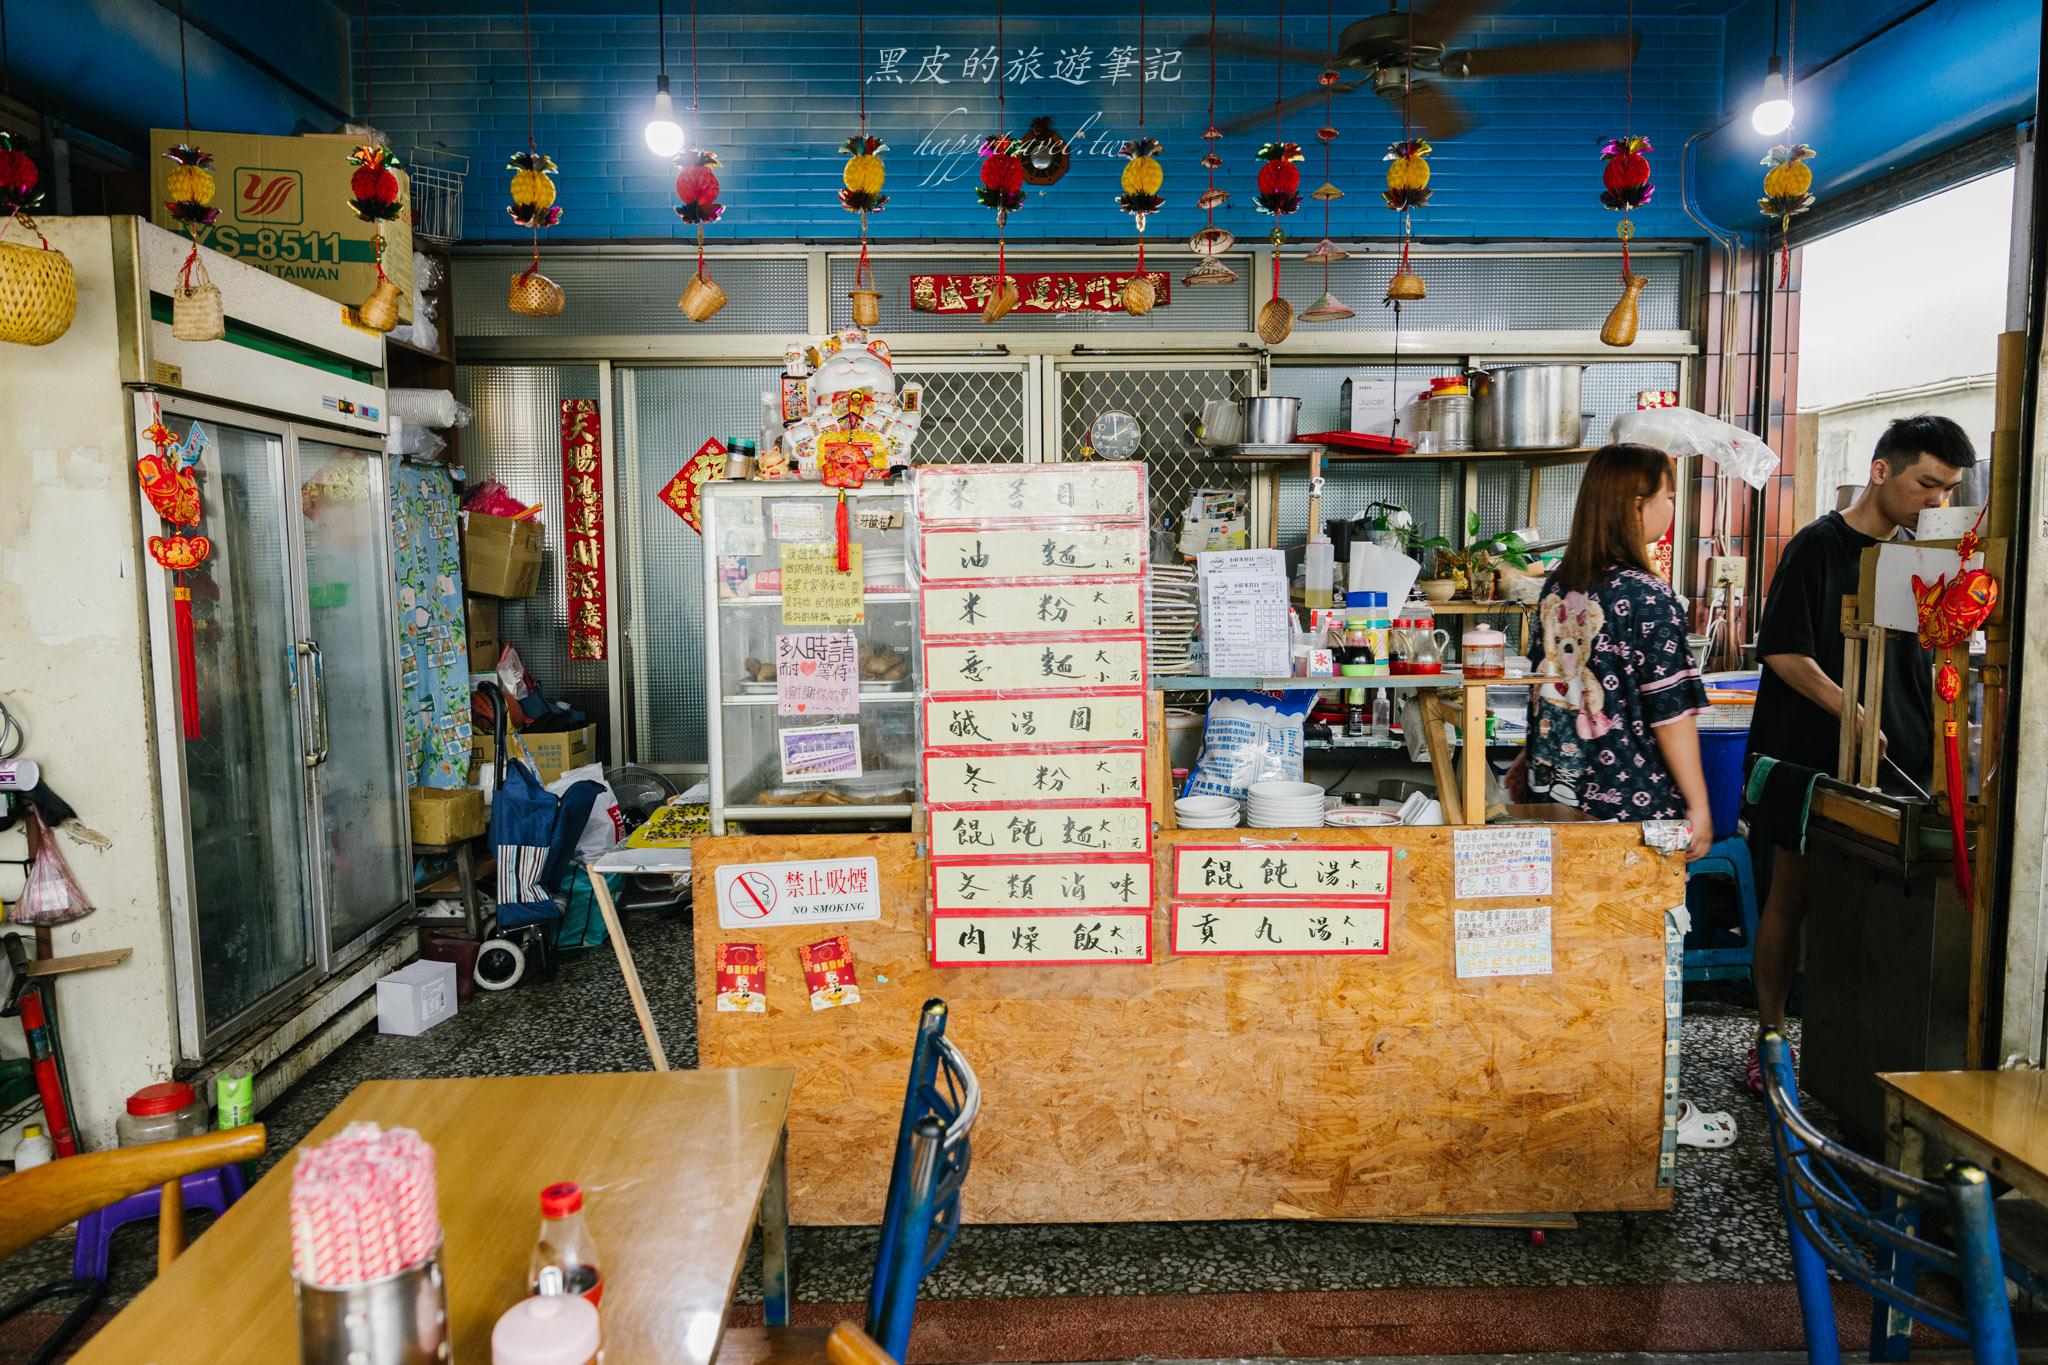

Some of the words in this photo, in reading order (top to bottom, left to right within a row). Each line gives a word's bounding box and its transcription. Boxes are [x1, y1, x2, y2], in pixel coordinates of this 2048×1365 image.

[274, 265, 339, 281] TAIWAN
[949, 478, 1075, 511] 米苔目
[1102, 536, 1115, 547] 大
[959, 538, 1096, 569] 油麵
[1101, 560, 1113, 569] 小
[1123, 552, 1135, 566] 元
[1092, 591, 1109, 604] 大
[958, 591, 1076, 625] 米粉
[1093, 616, 1107, 626] 小
[1125, 611, 1135, 624] 元
[780, 635, 856, 663] 多人時請
[1095, 649, 1111, 664] 大
[779, 661, 799, 677] 耐
[816, 661, 848, 682] 等待
[959, 647, 1086, 682] 意麵
[1094, 671, 1110, 682] 小
[1129, 669, 1140, 682] 元
[949, 706, 1092, 742] 鹹湯圓
[1115, 706, 1139, 729] 50
[1132, 728, 1142, 739] 元
[1096, 761, 1111, 773] 大
[963, 763, 1071, 793] 冬粉
[1096, 783, 1110, 794] 小
[1129, 776, 1140, 790] 元
[1584, 783, 1623, 805] Barbie
[952, 815, 1100, 848] 餛飩麵
[1100, 819, 1111, 832] 大
[1099, 840, 1111, 849] 小
[1130, 837, 1142, 849] 元
[1350, 859, 1362, 870] 大
[1201, 857, 1340, 890] 餛飩湯
[785, 867, 869, 899] 禁止吸煙
[1346, 879, 1358, 889] 小
[1374, 882, 1385, 893] 元
[792, 905, 808, 915] NO
[813, 902, 865, 914] SMOKING
[1192, 913, 1332, 945] 貢丸湯
[1343, 915, 1357, 927] 大
[958, 922, 1108, 955] 肉燥飯
[1110, 926, 1125, 939] 大
[1108, 946, 1123, 956] 小
[1135, 946, 1144, 956] 元
[1342, 936, 1354, 946] 小
[1373, 939, 1383, 949] 元
